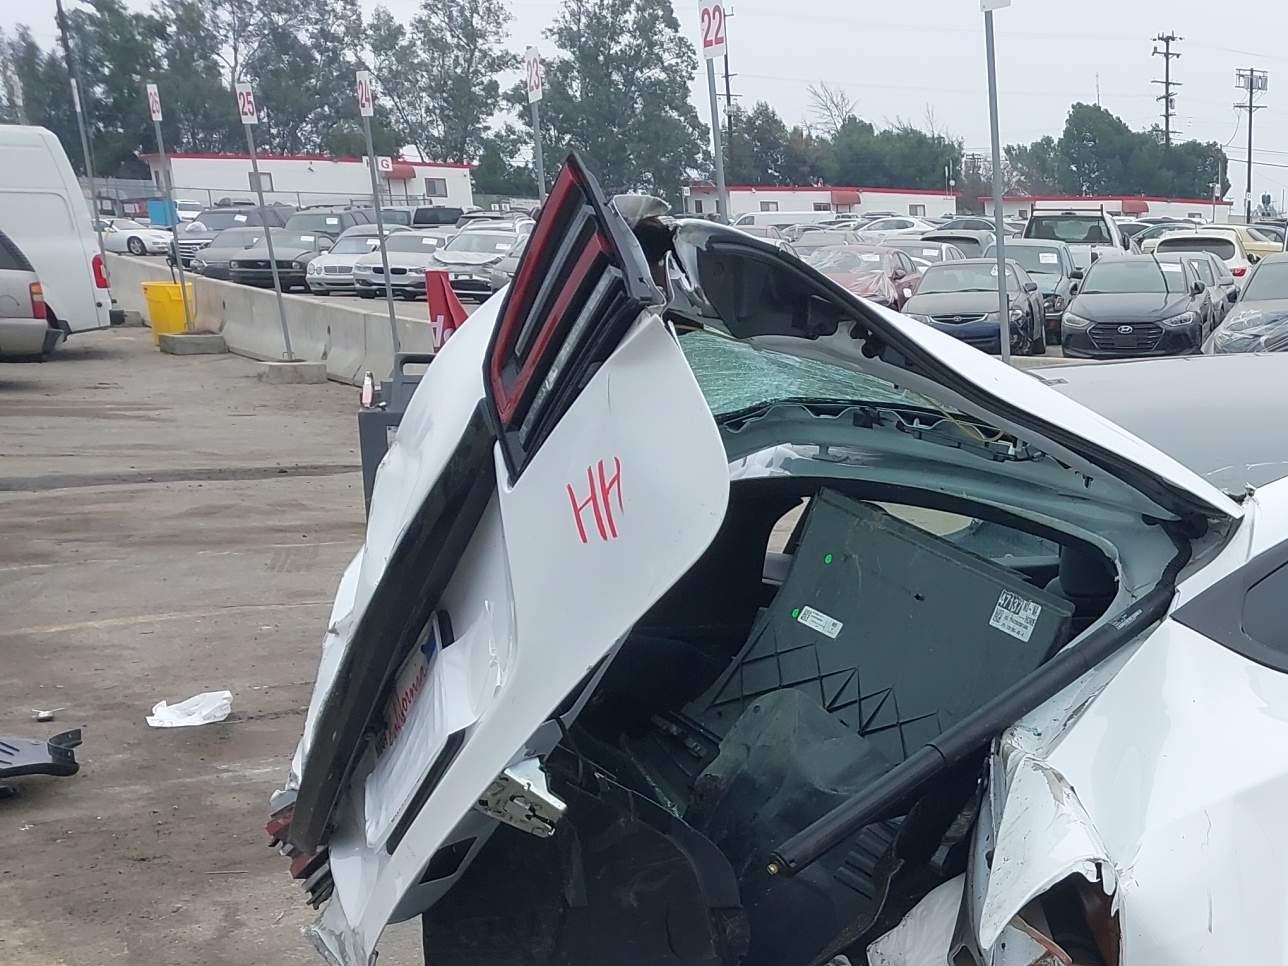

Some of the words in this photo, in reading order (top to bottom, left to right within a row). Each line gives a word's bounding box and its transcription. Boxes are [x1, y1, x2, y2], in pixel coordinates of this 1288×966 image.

[701, 4, 724, 48] 22
[526, 57, 540, 92] 23
[238, 91, 255, 117] 25
[358, 79, 374, 108] 24
[567, 456, 624, 543] HH
